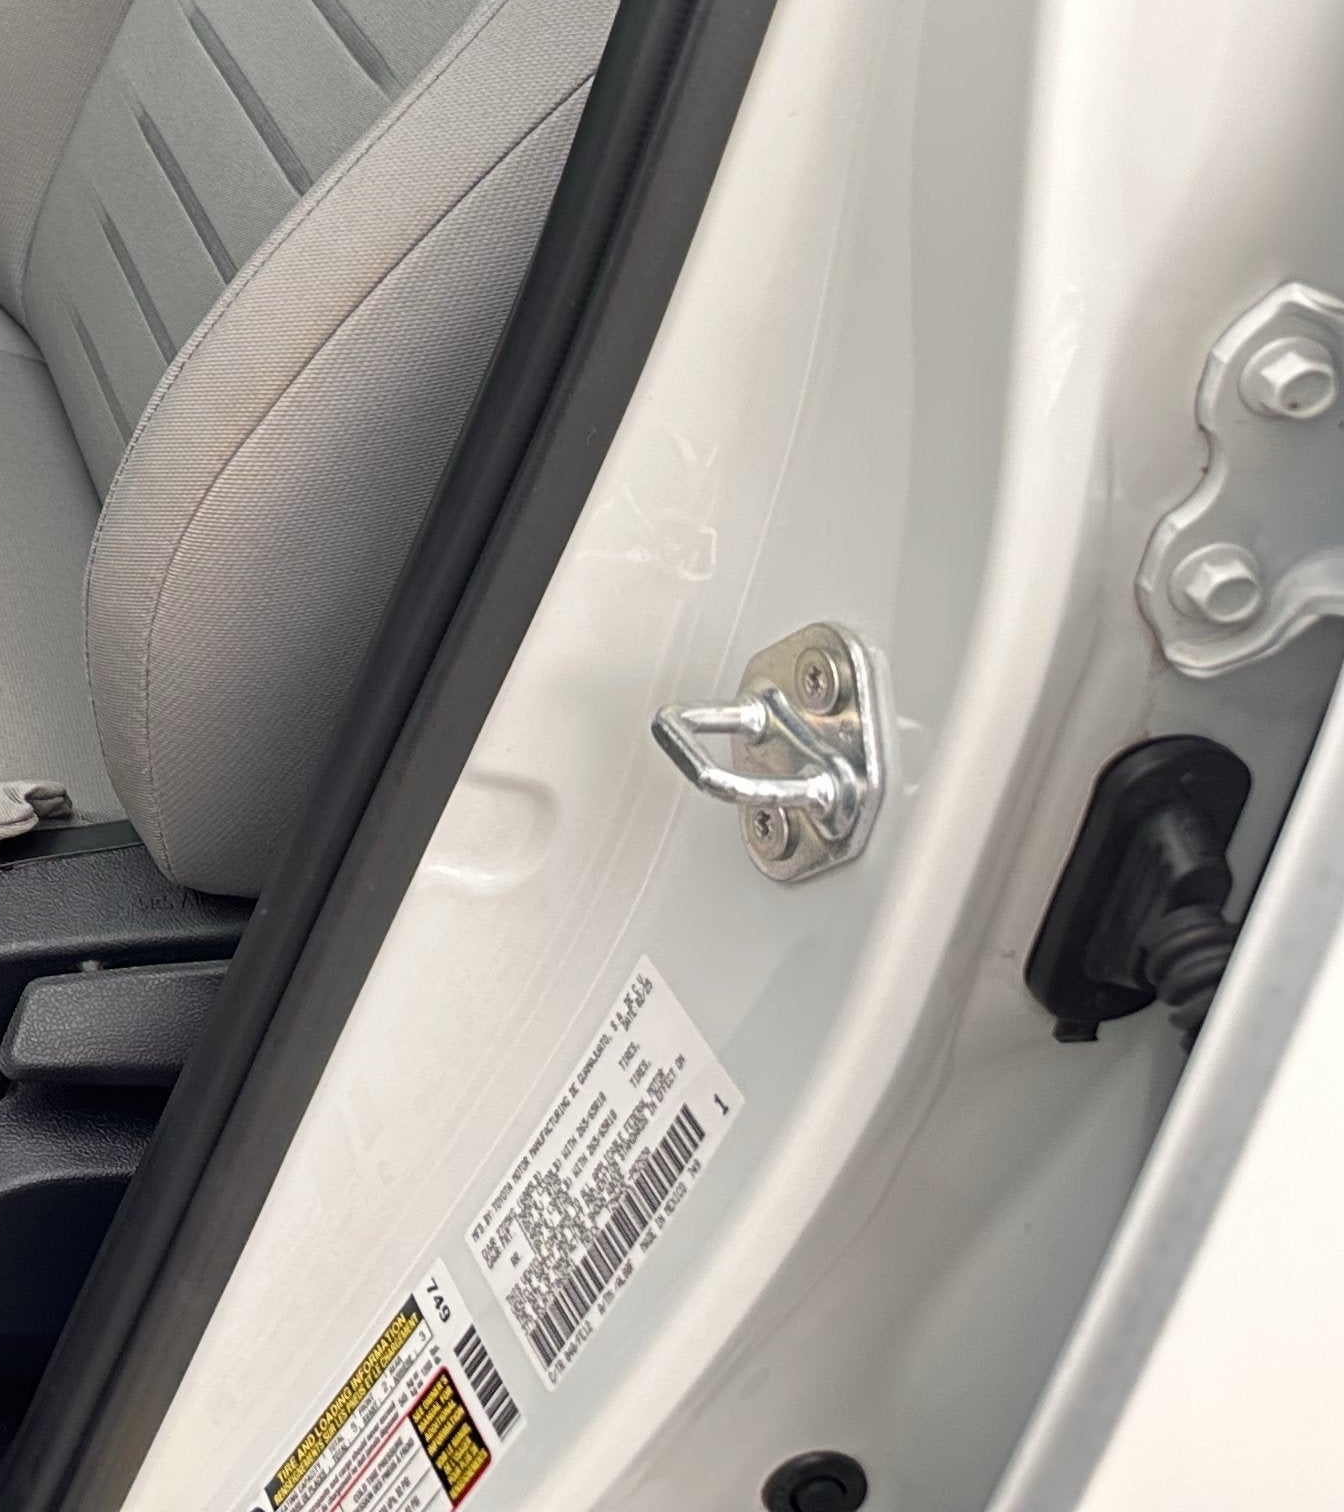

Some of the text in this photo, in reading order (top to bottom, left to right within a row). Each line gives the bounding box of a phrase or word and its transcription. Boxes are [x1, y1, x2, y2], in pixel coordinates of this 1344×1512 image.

[713, 1093, 729, 1116] 1
[492, 1179, 512, 1212] TOYOTA
[512, 1154, 529, 1184] MOTOR
[528, 1094, 569, 1160] MANUFACTURING
[663, 1180, 686, 1216] MEXICO
[424, 1276, 450, 1323] 749
[278, 1454, 297, 1484] TIRE
[296, 1431, 315, 1461] AND
[314, 1384, 351, 1438] LOADING
[350, 1312, 406, 1390] INFORMATION
